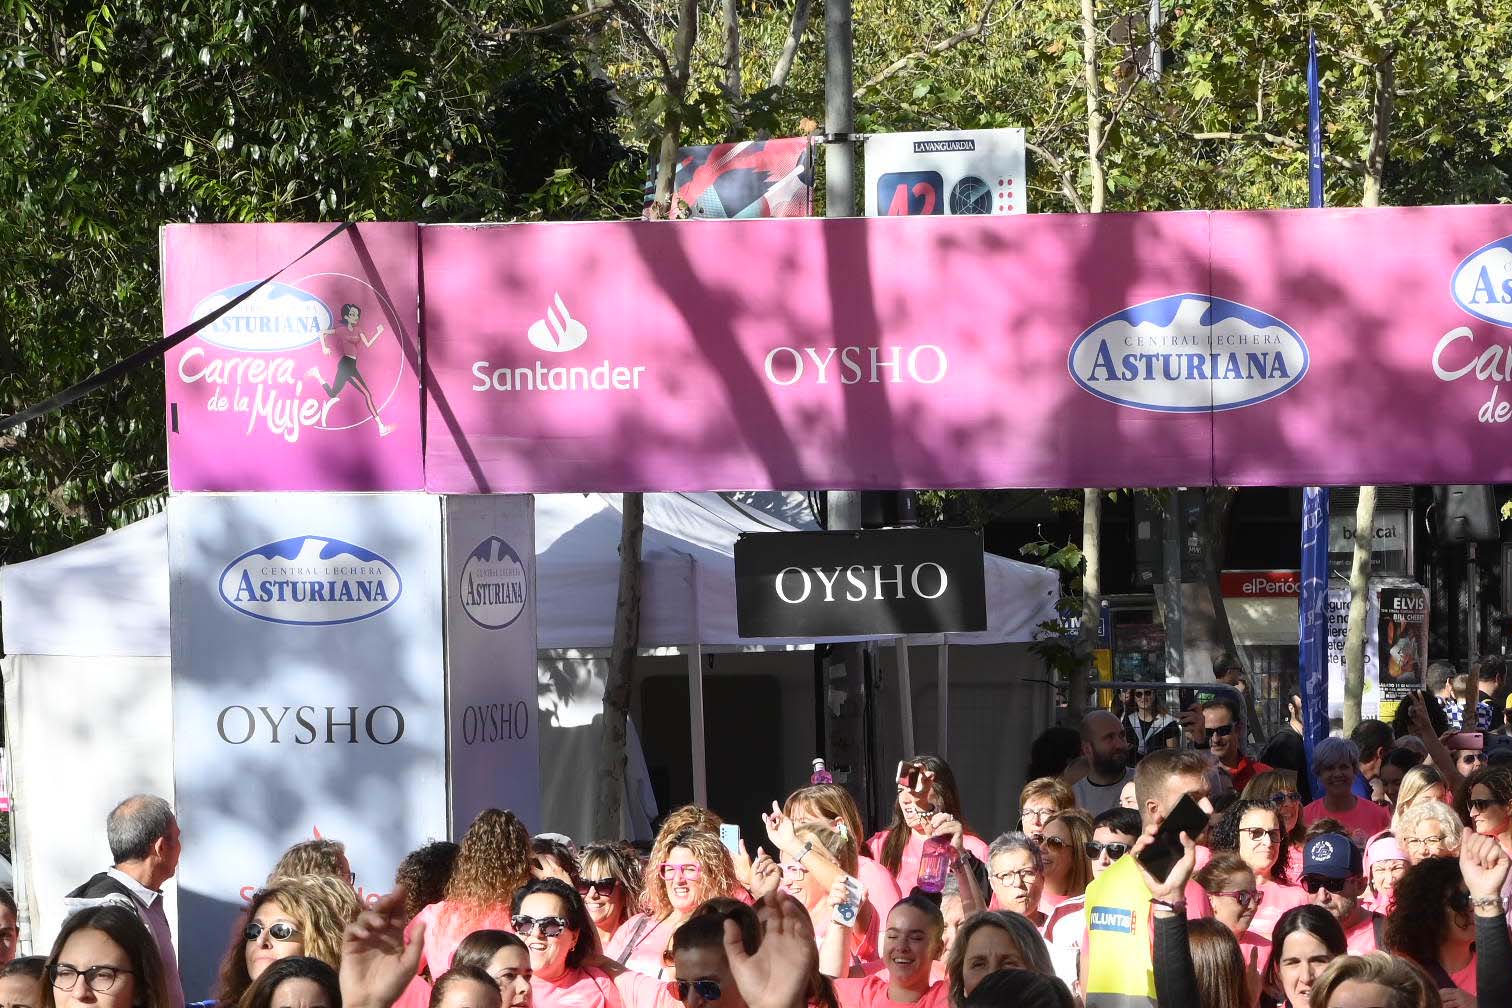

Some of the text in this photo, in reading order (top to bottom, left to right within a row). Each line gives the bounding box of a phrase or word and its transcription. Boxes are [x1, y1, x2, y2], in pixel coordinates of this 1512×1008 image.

[1124, 333, 1282, 347] CENTRAL LECHERA
[178, 346, 296, 385] Carrera
[472, 358, 645, 393] Santander
[764, 344, 948, 386] OYSHO
[1087, 339, 1291, 383] ASTURIANA
[208, 380, 341, 442] de la Mujer
[1478, 385, 1512, 424] de
[234, 568, 389, 602] ASTURIANA
[261, 566, 383, 576] CENTRAL LECHERA
[466, 572, 523, 606] ASTURIANA
[775, 561, 949, 604] OYSHO
[1394, 597, 1424, 610] ELVIS
[217, 704, 405, 745] OYSHO
[463, 701, 529, 745] OYSHO
